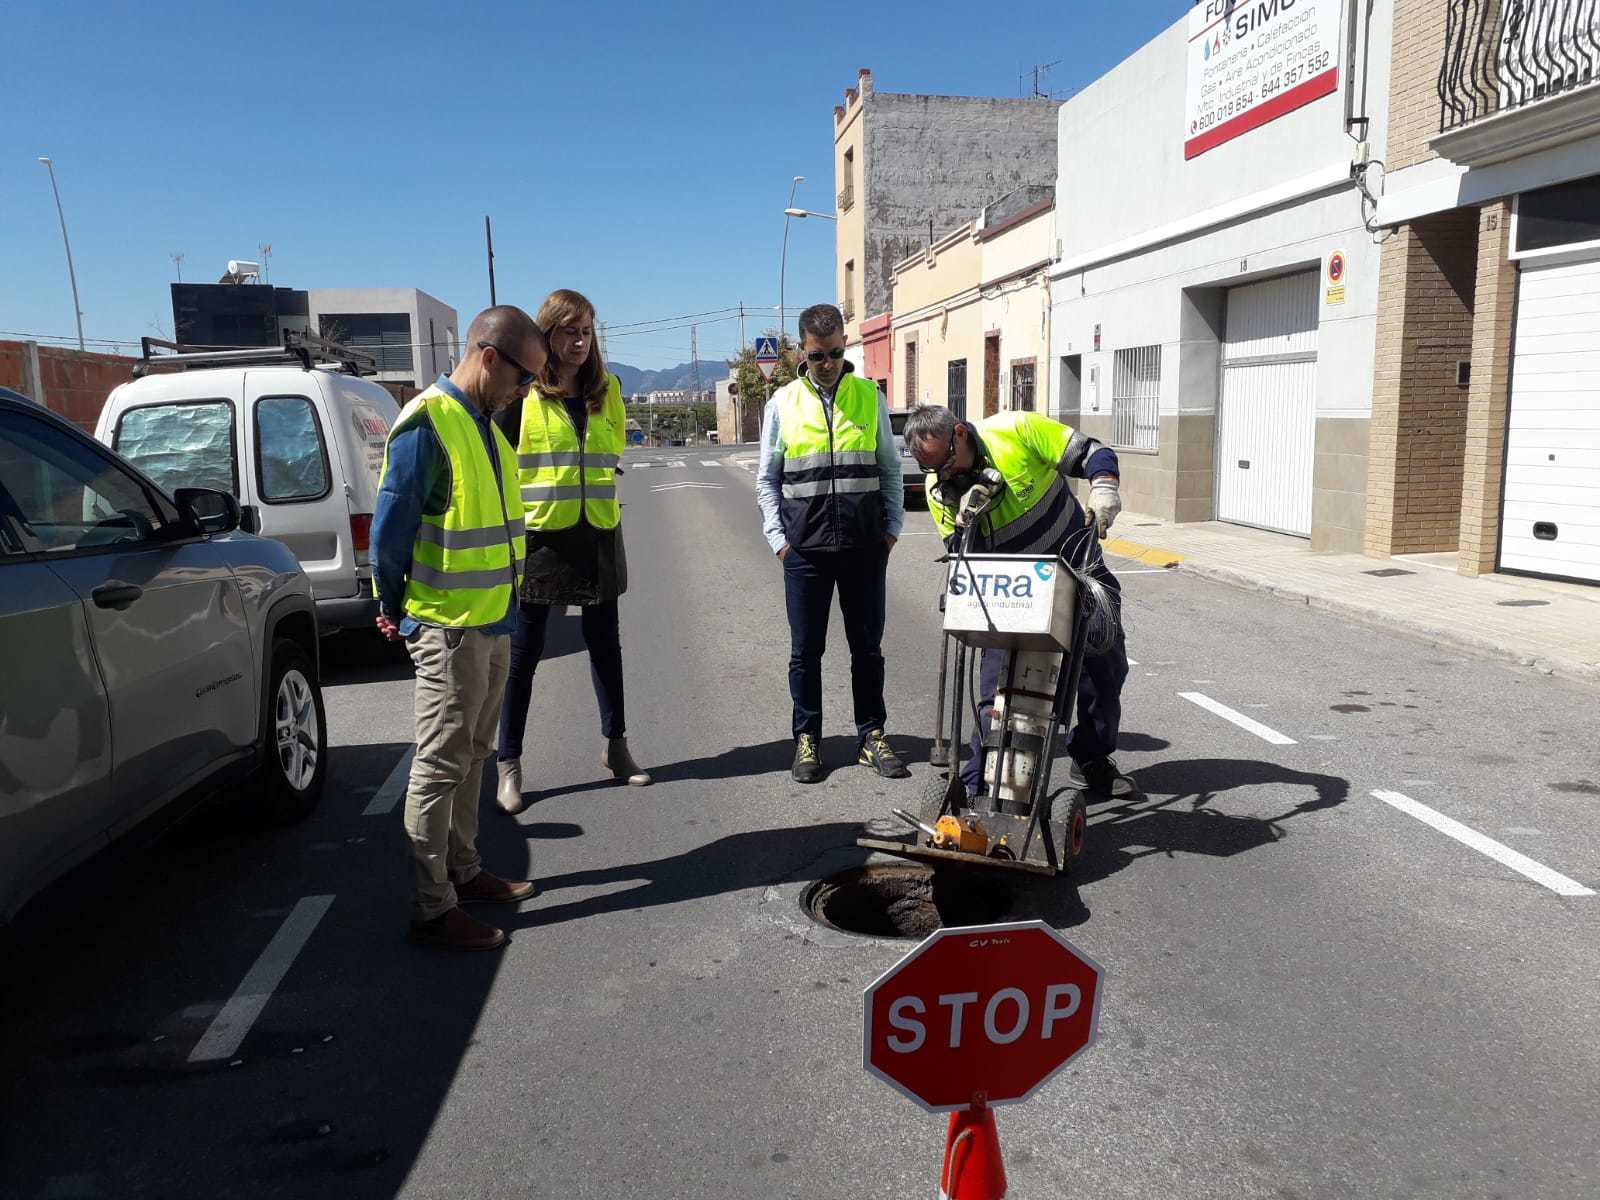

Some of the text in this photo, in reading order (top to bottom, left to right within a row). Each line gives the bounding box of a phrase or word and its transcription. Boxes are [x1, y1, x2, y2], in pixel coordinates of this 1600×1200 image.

[1199, 112, 1215, 130] 600
[1217, 101, 1234, 121] 019
[1235, 90, 1253, 112] 654
[1261, 77, 1281, 99] 644
[1284, 63, 1304, 87] 357
[1307, 50, 1330, 75] 552
[1271, 62, 1283, 76] de
[1286, 41, 1321, 67] Fincas
[886, 983, 1082, 1053] STOP
